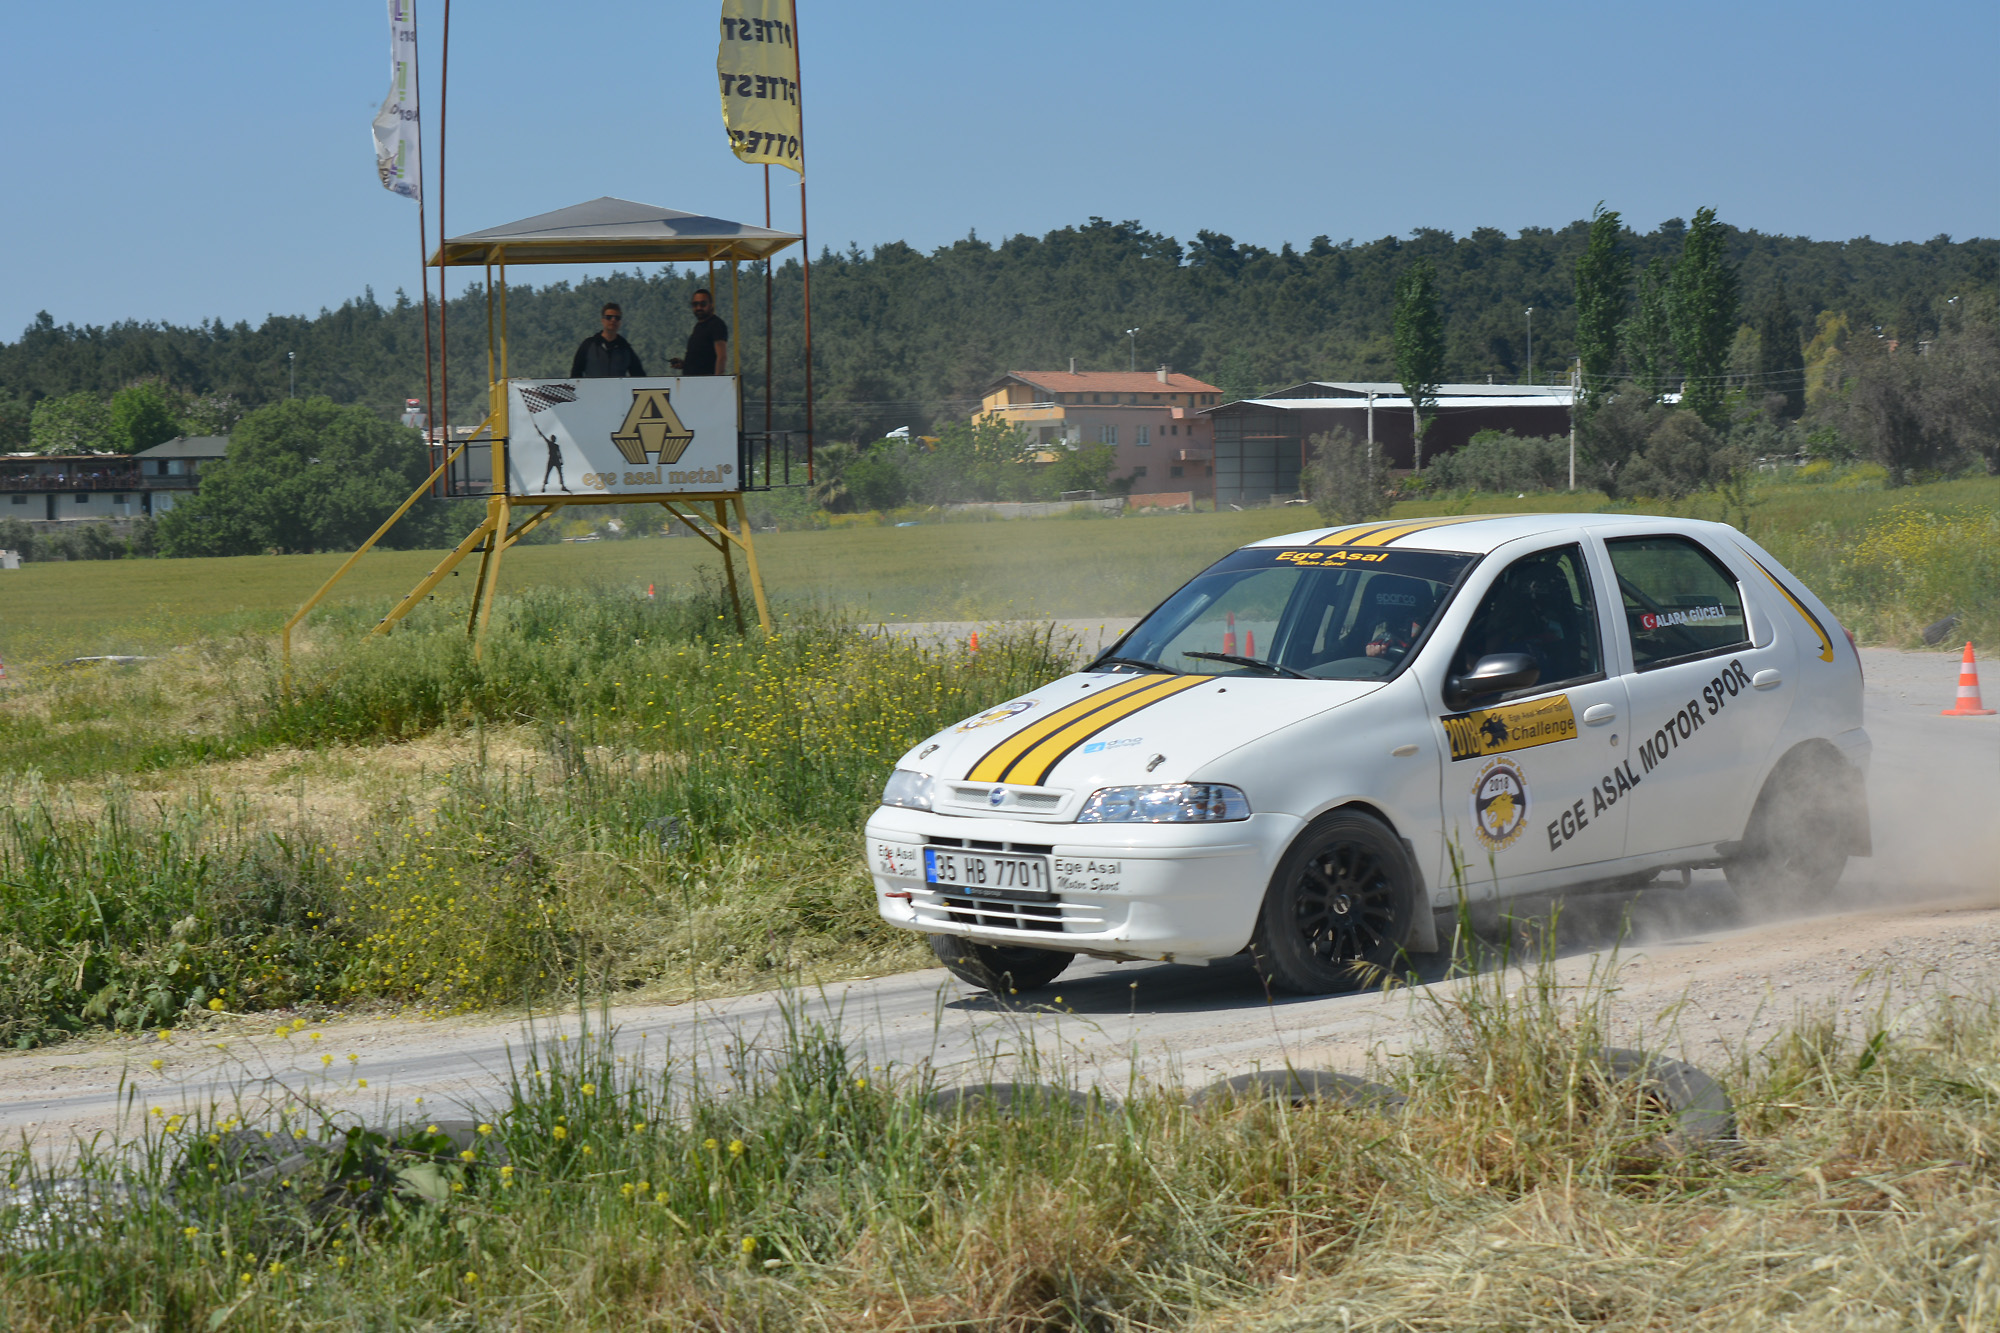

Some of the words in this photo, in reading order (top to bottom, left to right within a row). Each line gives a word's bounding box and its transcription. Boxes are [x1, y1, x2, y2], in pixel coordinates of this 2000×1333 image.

[582, 471, 617, 490] ege
[623, 466, 662, 485] asal
[1275, 551, 1324, 562] Ege
[1326, 550, 1389, 563] Asal
[1376, 592, 1416, 605] sparco
[1655, 611, 1689, 628] ALARA
[1507, 714, 1521, 722] Ege
[1443, 716, 1481, 758] 2018
[1512, 718, 1575, 740] Challenge
[1547, 799, 1589, 852] EGE
[1591, 759, 1641, 818] ASAL
[1638, 699, 1706, 774] MOTOR
[1702, 658, 1751, 716] SPOR
[1489, 776, 1510, 792] 2018
[896, 847, 917, 860] Asal
[936, 854, 956, 881] 35
[964, 857, 987, 884] HB
[995, 859, 1041, 888] 7701
[1055, 859, 1083, 875] Ege
[1086, 860, 1121, 874] Asal
[1057, 876, 1087, 889] Motor
[1090, 878, 1120, 894] Sport
